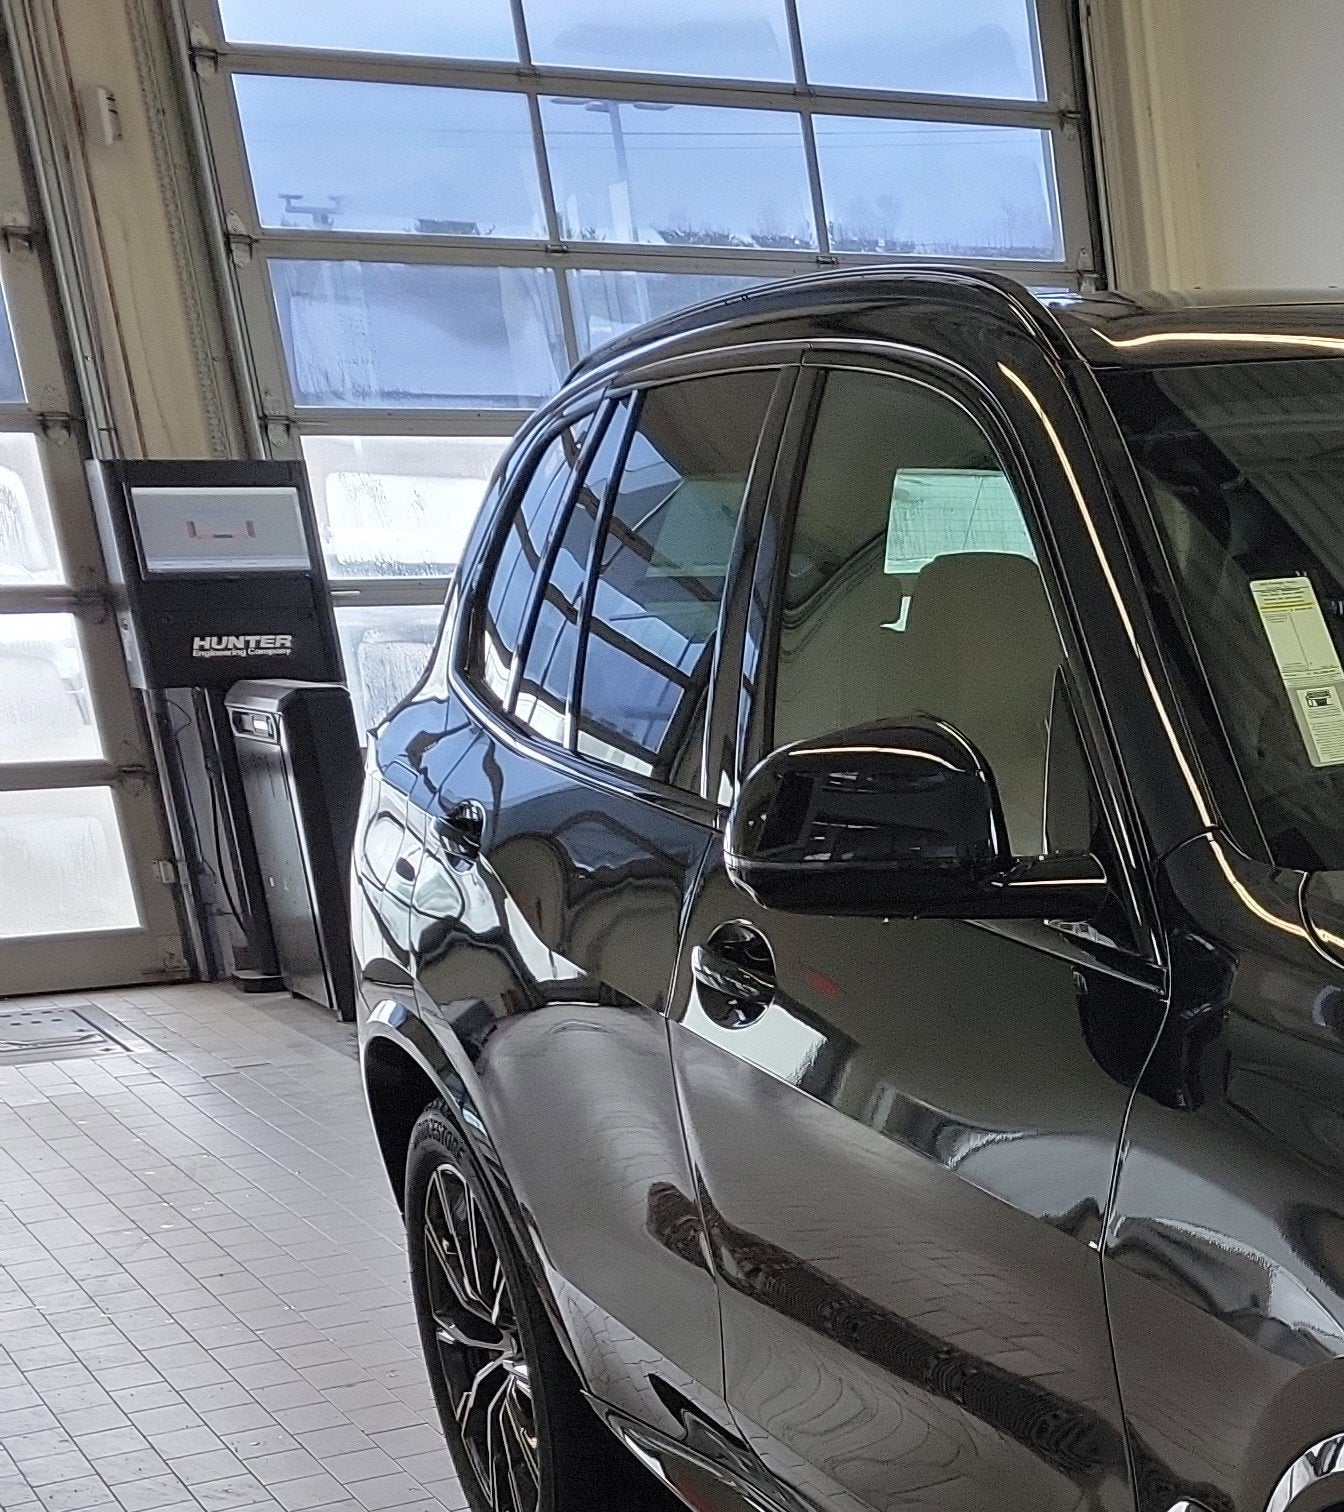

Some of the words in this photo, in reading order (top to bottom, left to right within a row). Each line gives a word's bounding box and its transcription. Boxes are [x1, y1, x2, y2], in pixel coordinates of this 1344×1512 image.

[193, 635, 293, 650] HUNTER
[193, 648, 247, 658] Engineering
[248, 647, 292, 656] Company
